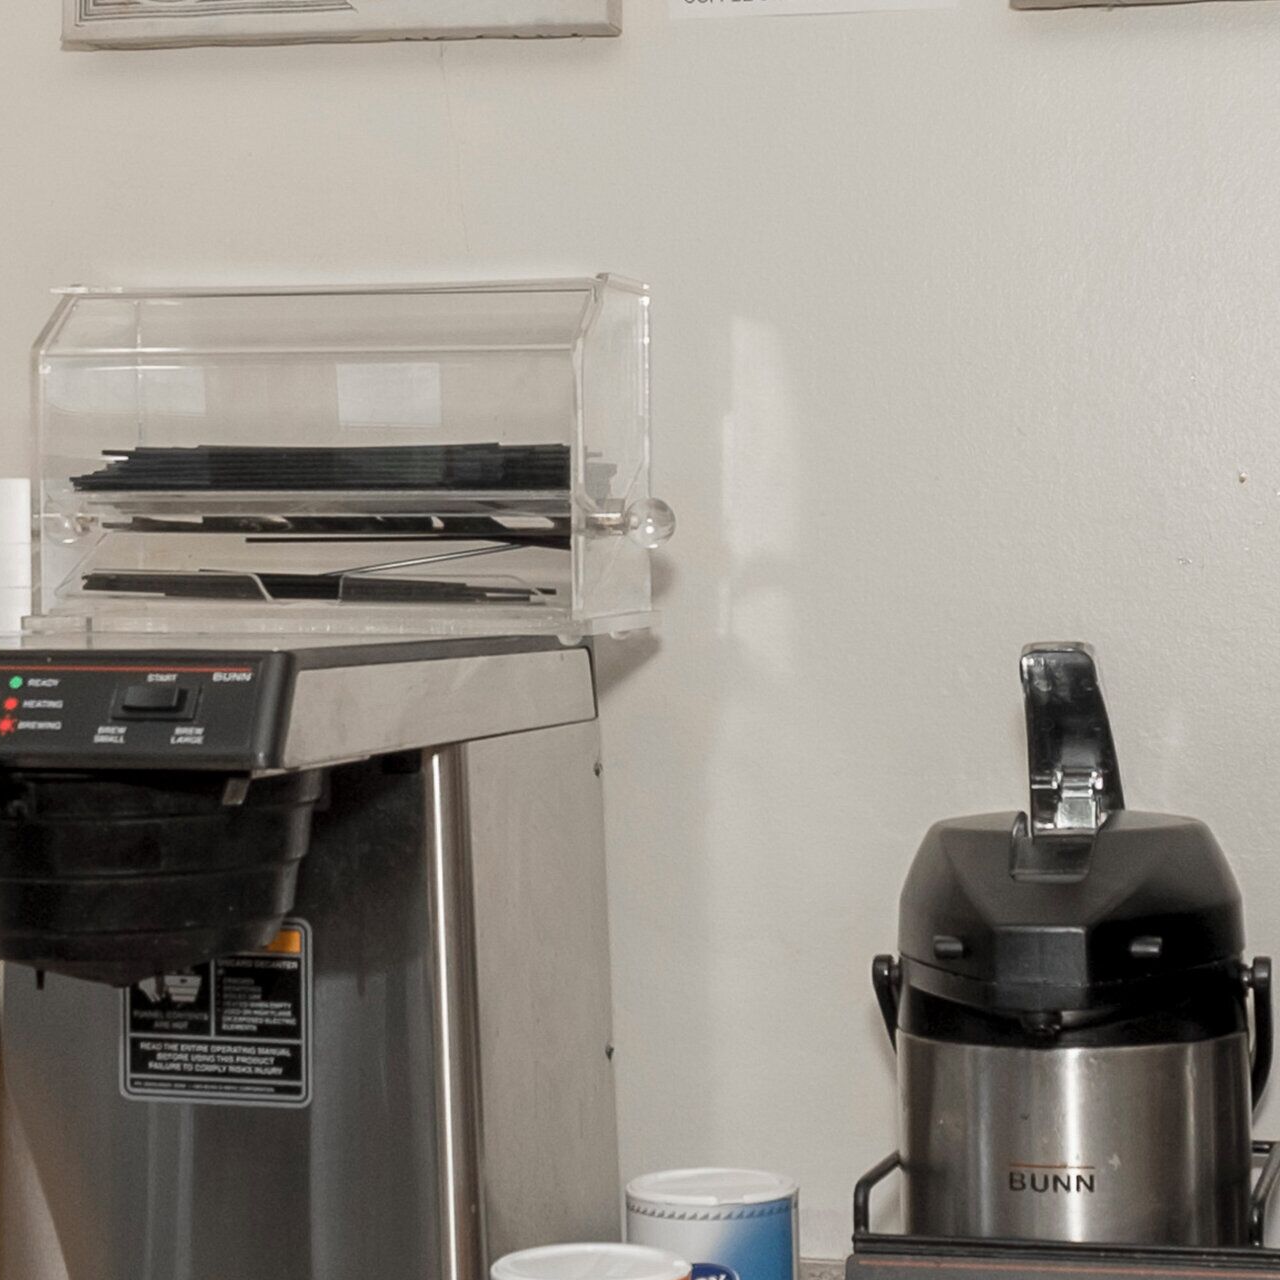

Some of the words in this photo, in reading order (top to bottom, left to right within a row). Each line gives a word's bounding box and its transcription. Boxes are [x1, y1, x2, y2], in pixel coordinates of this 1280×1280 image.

[147, 673, 178, 682] START
[212, 672, 252, 682] BUNN
[27, 678, 59, 687] READY
[23, 699, 63, 709] HEATING
[17, 721, 61, 730] BREWING
[97, 725, 127, 734] BREW
[174, 727, 204, 736] BREW
[93, 734, 125, 743] SMALL
[170, 735, 204, 744] LARGE
[1008, 1171, 1095, 1193] BUNN
